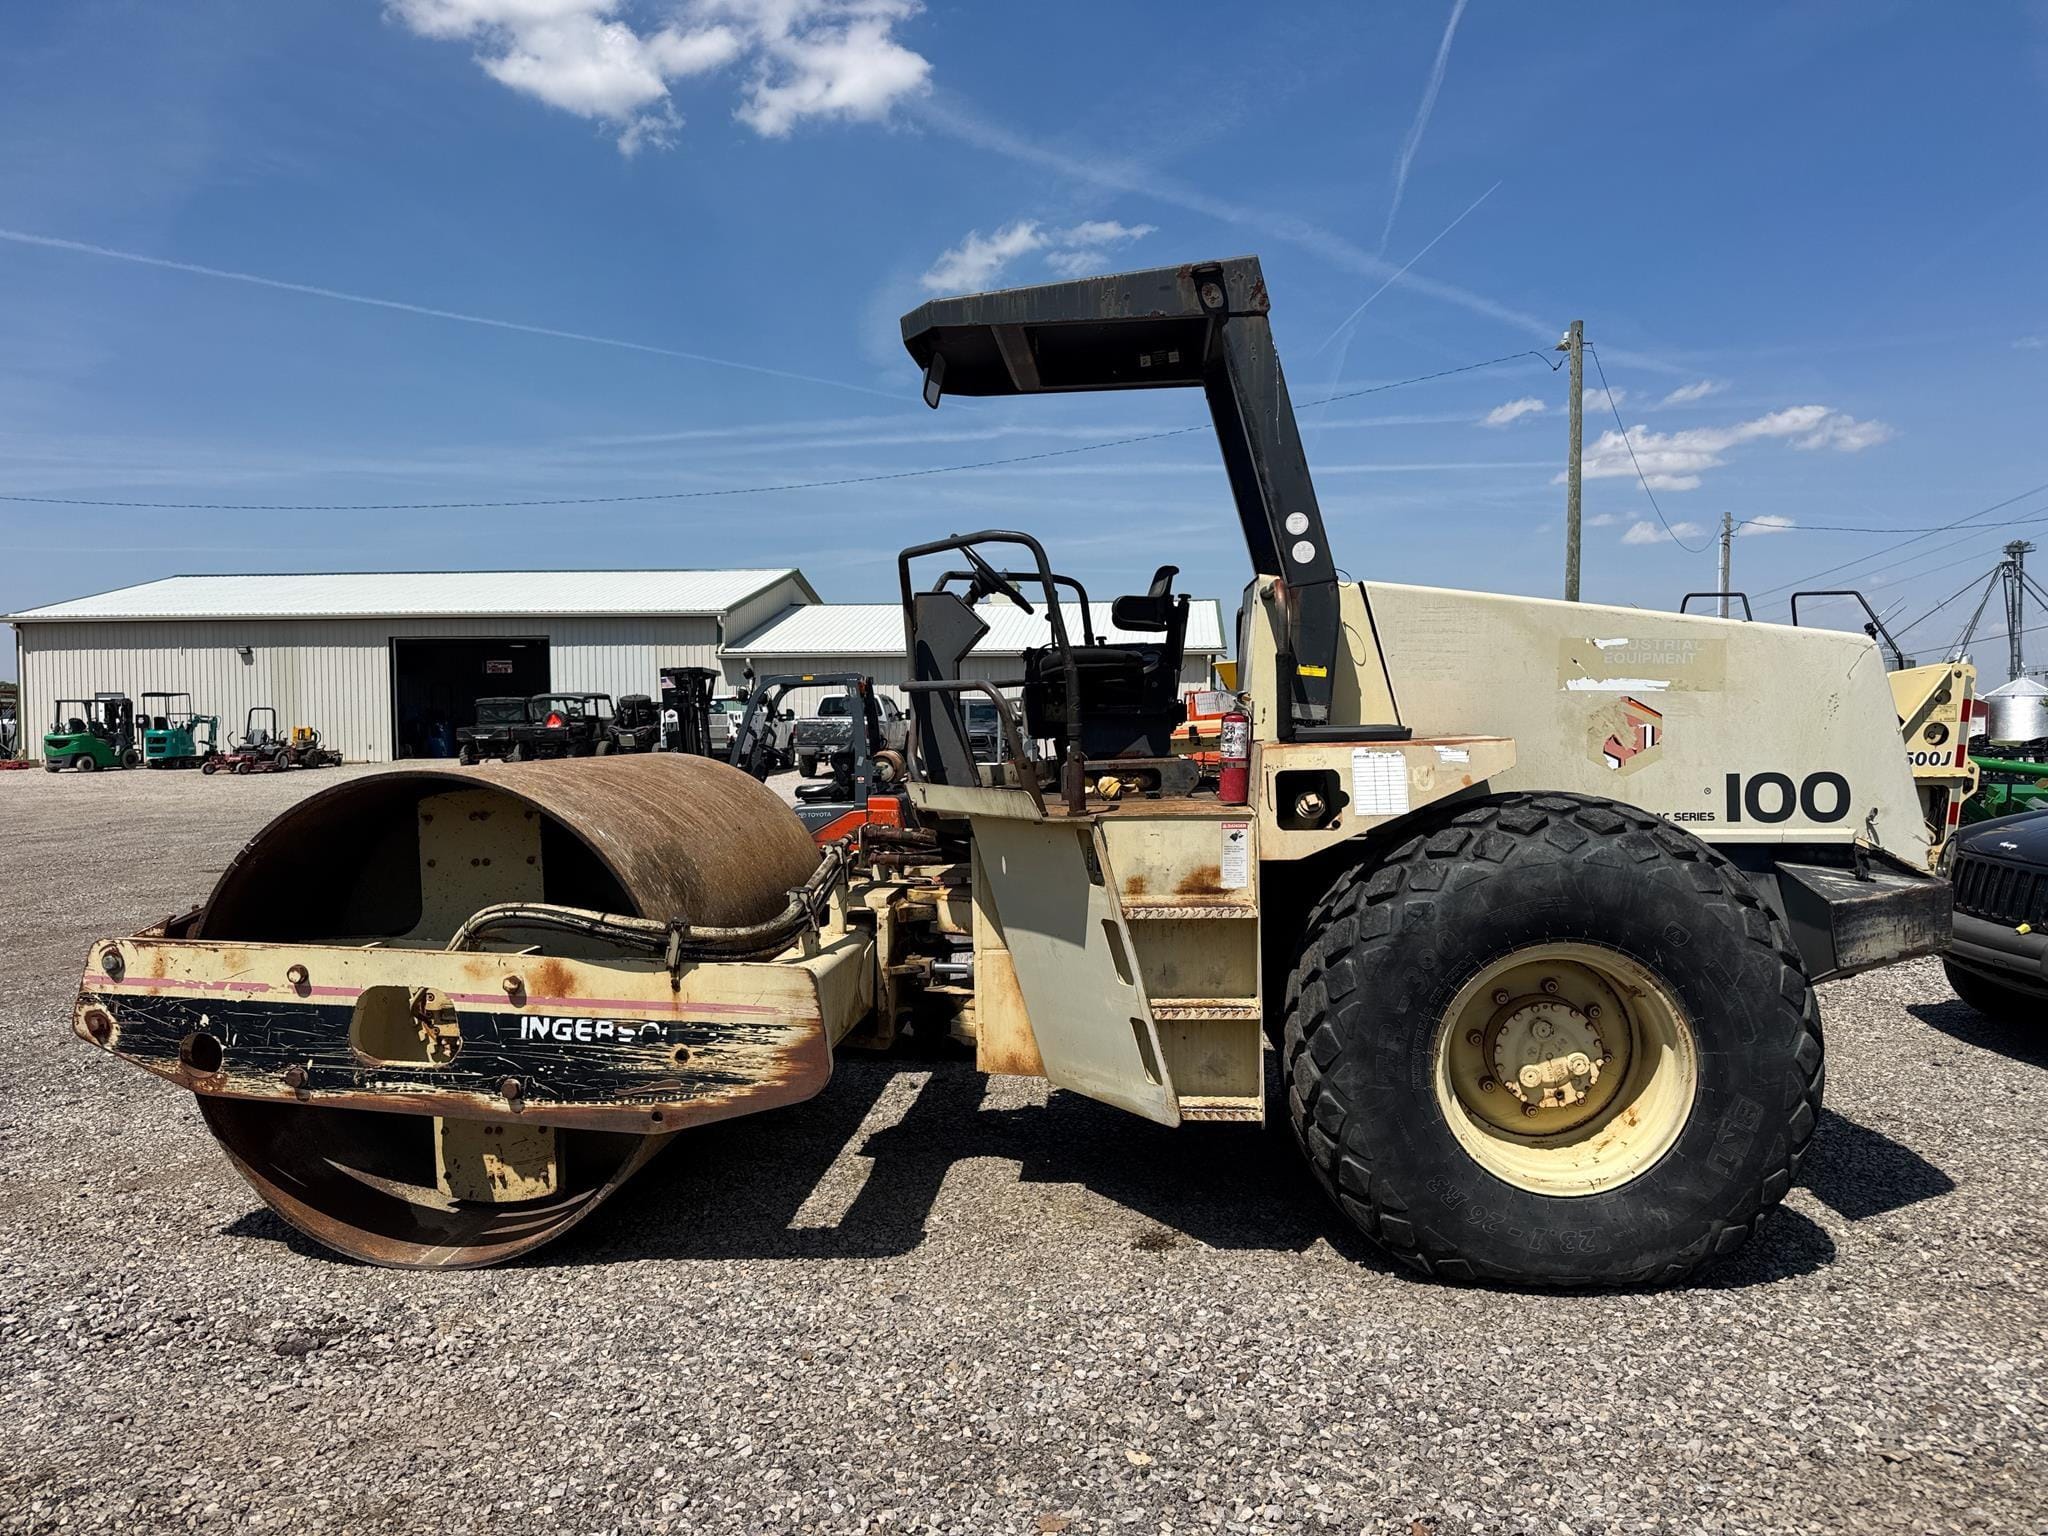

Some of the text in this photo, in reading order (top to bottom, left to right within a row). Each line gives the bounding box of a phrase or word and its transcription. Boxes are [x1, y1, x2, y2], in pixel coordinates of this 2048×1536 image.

[1603, 650, 1698, 665] EQUIPMENT
[1725, 771, 1852, 824] 100
[1673, 811, 1716, 822] SERIES
